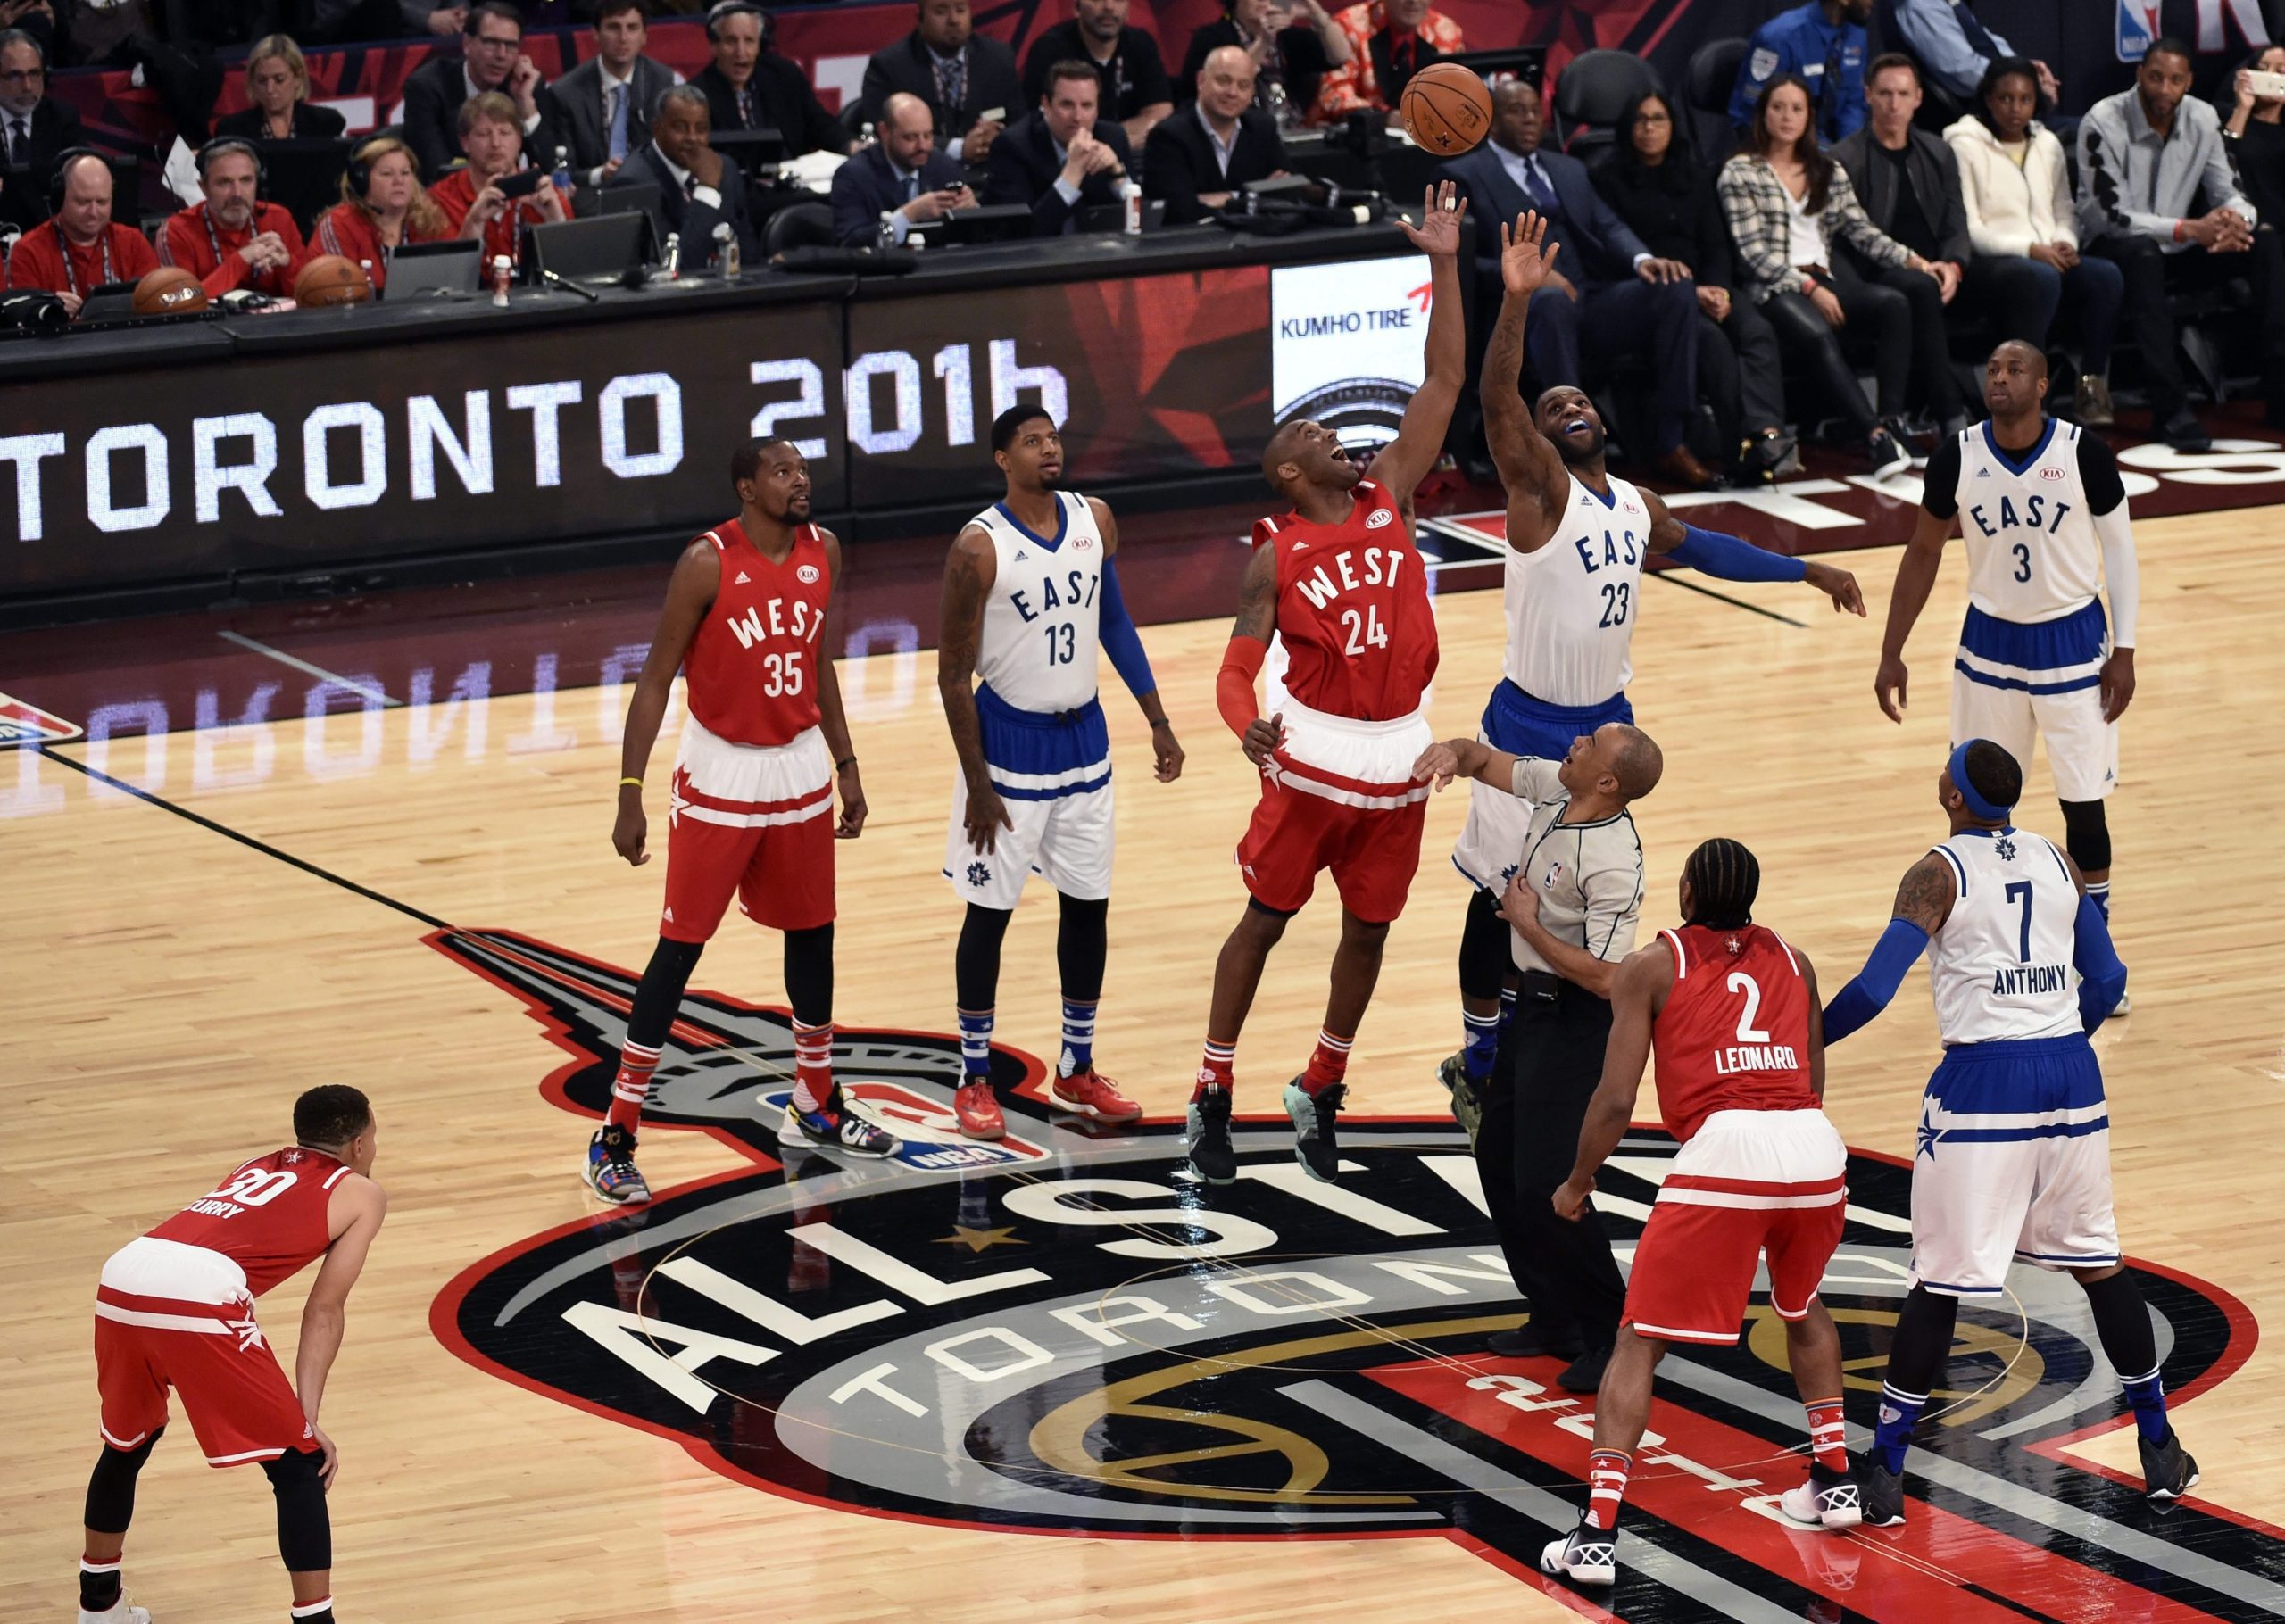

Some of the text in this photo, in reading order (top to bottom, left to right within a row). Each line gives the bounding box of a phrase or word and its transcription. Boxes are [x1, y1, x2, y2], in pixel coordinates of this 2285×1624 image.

[1281, 308, 1412, 340] KUMHO TIRE
[0, 339, 1068, 540] TORONTO 2016
[1969, 494, 2071, 538] EAST
[1296, 547, 1405, 610] WEST
[2012, 543, 2032, 584] 3
[1010, 570, 1099, 623] EAST
[1600, 581, 1631, 629] 23
[727, 597, 825, 650] WEST
[1044, 622, 1076, 667] 13
[1340, 603, 1389, 656] 24
[763, 651, 803, 699] 35
[2004, 880, 2034, 964] 7
[1992, 964, 2068, 995] ANTHONY
[1726, 972, 1771, 1043] 2
[1713, 1045, 1799, 1075] LEONARD
[910, 1148, 1008, 1168] NBA
[182, 1198, 245, 1219] CURRY
[207, 1167, 298, 1207] 30
[561, 1221, 1052, 1415] ALL
